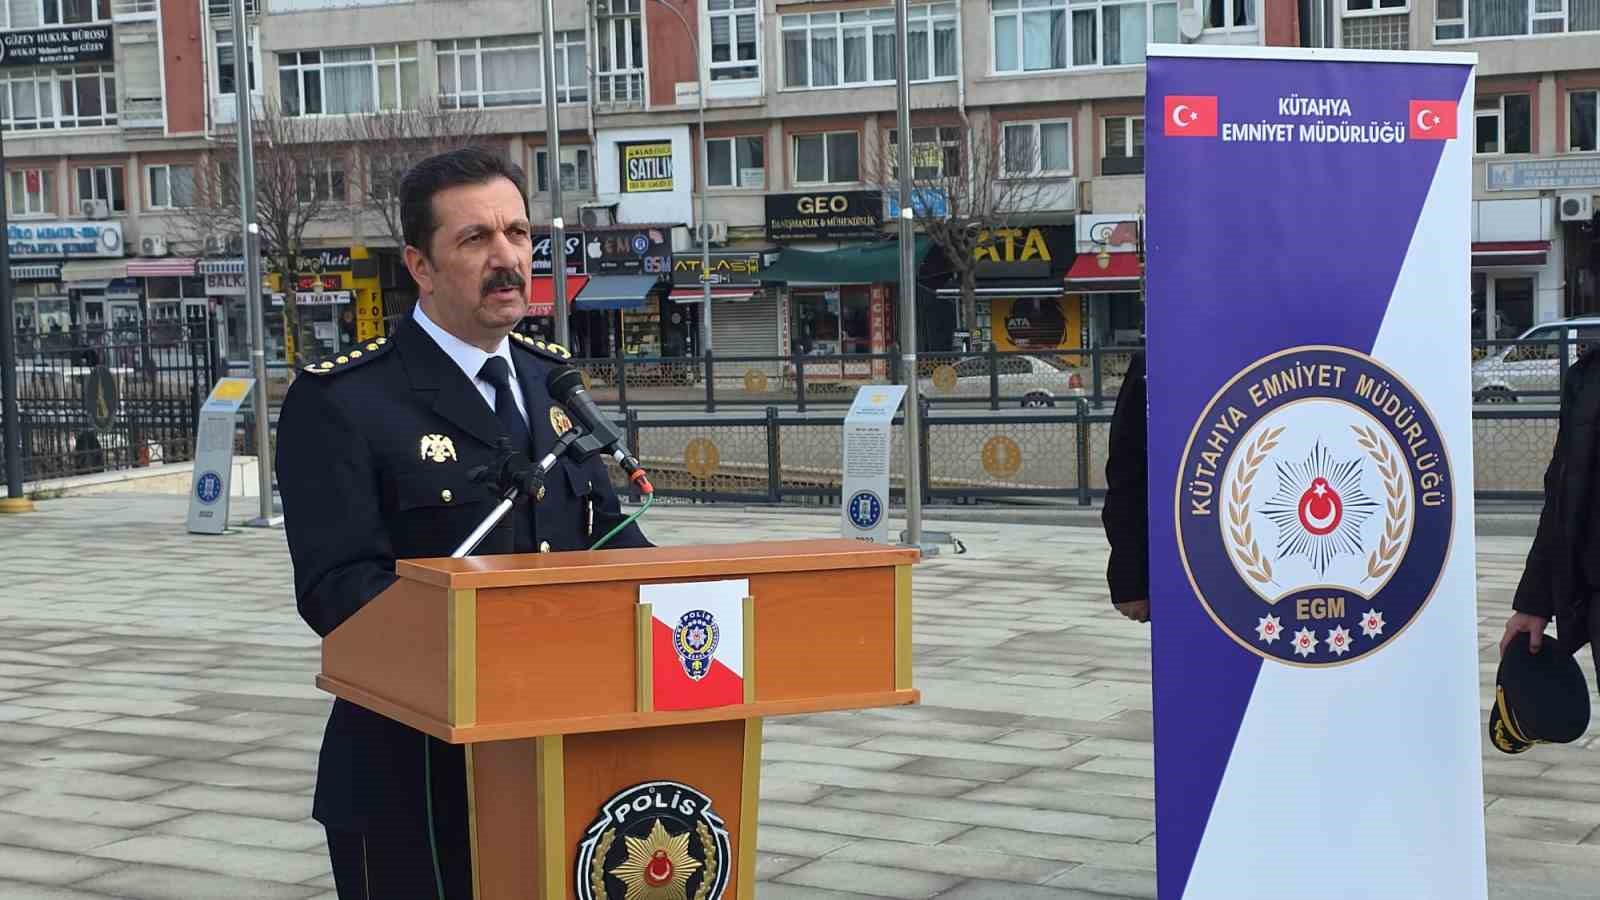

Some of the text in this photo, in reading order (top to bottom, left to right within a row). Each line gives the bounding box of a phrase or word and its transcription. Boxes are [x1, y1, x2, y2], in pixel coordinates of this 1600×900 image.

[37, 31, 70, 43] HUKUK
[71, 28, 108, 40] BÜROSU
[1278, 93, 1351, 117] KÜTAHYA
[1222, 119, 1405, 143] EMNİYET MÜDÜRLÜĞÜ
[797, 195, 848, 215] GEO
[643, 255, 672, 273] GSM
[1191, 360, 1446, 516] KÜTAHYA EMNİYET MÜDÜRLÜĞÜ
[1296, 597, 1346, 620] EGM
[614, 789, 697, 823] POLİS
